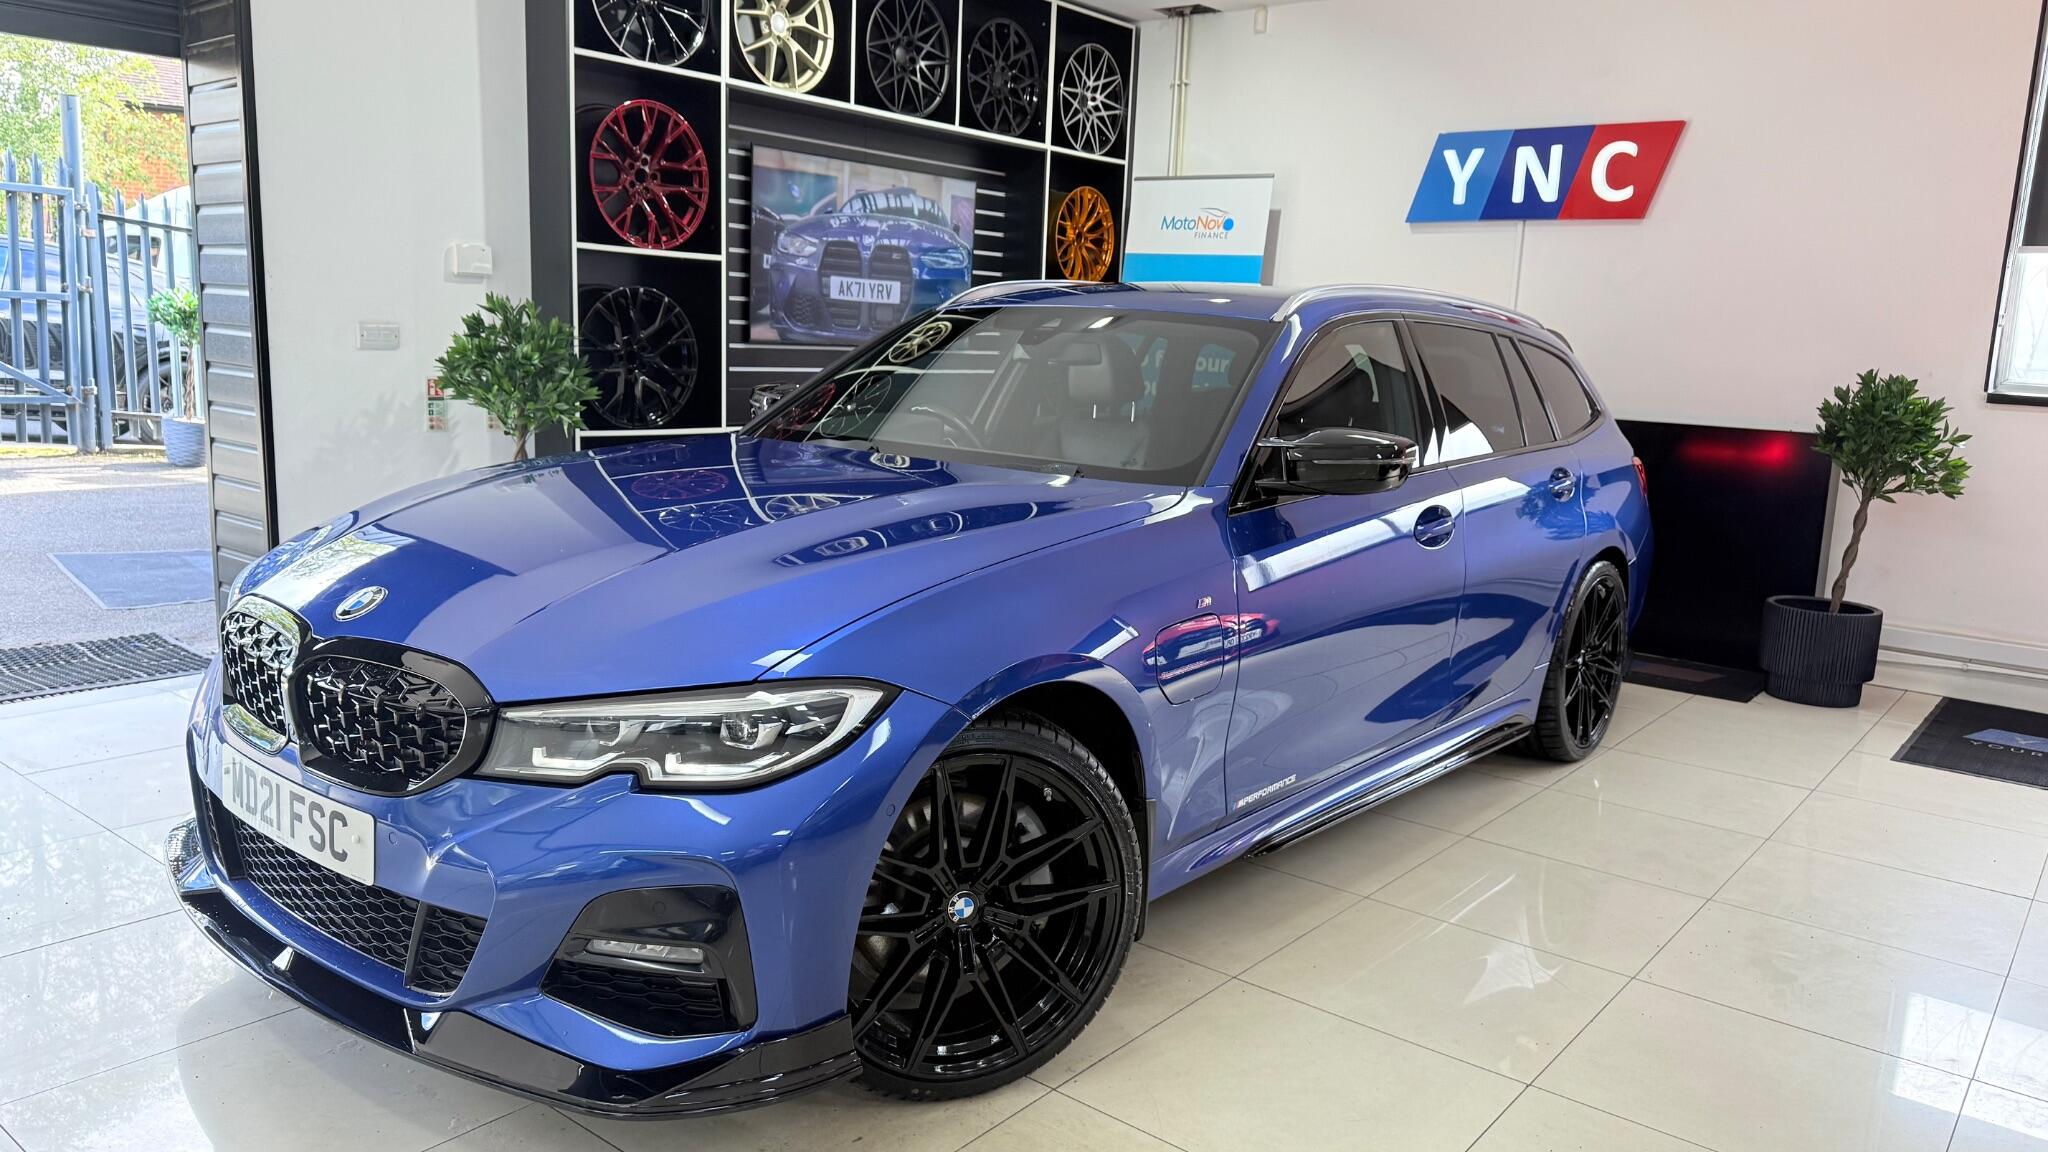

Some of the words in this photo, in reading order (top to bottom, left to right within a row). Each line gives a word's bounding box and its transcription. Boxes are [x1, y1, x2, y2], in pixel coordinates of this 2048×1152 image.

[1443, 140, 1638, 205] YNC
[1193, 231, 1229, 240] FINANCE
[838, 279, 866, 298] AK71
[868, 282, 893, 301] YRV
[1969, 740, 2044, 757] YOUR
[289, 790, 349, 863] FSC
